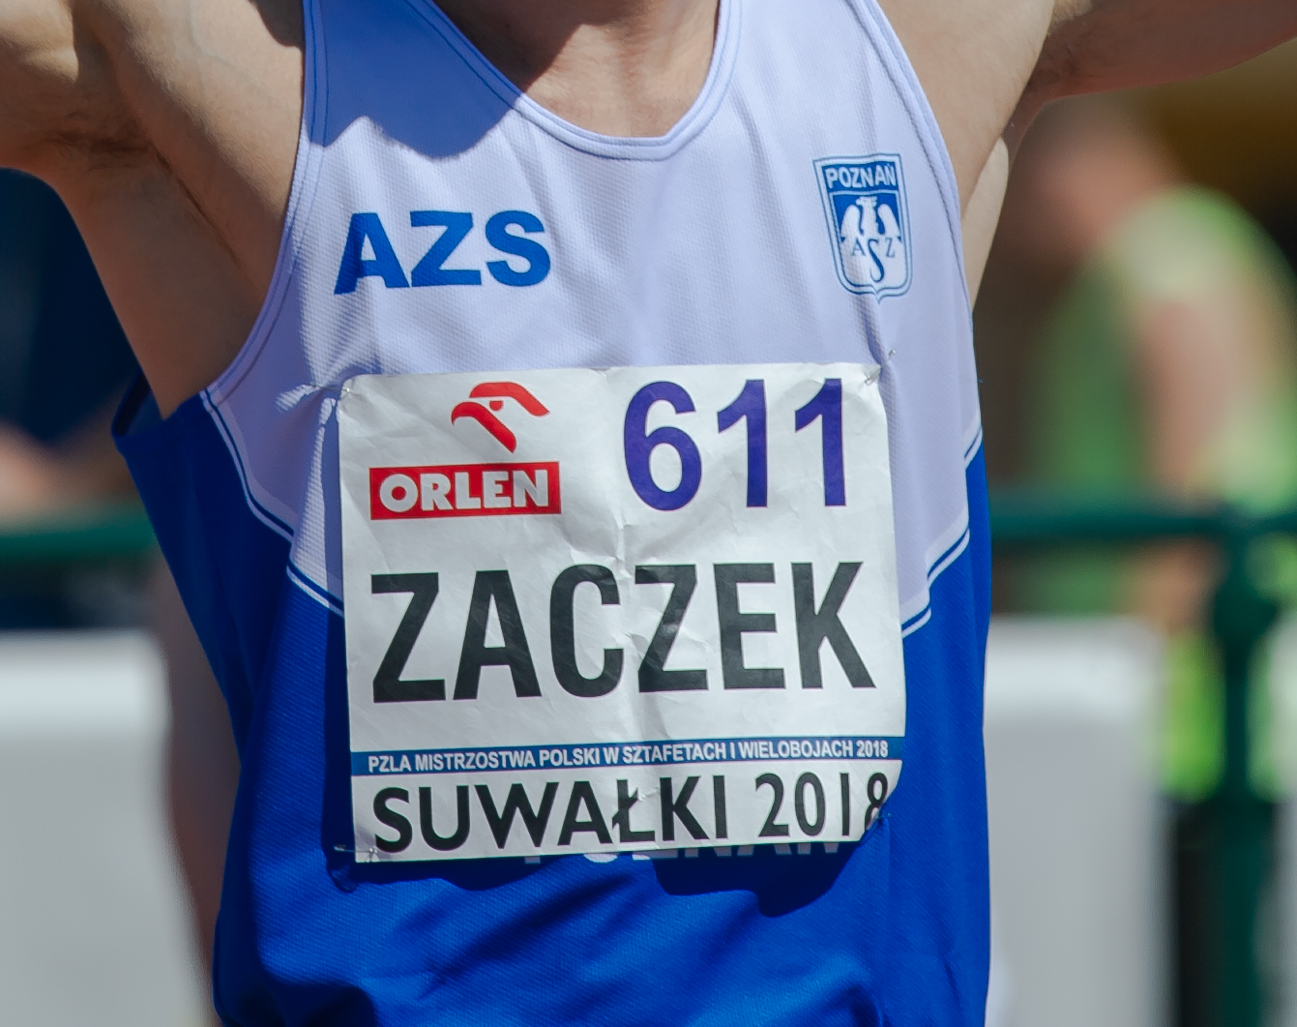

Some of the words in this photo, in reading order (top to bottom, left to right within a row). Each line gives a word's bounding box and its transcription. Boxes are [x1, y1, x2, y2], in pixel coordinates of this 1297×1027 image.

[824, 163, 897, 189] POZNAŃ
[334, 210, 551, 295] AZS
[623, 378, 847, 511] 611
[378, 469, 550, 514] ORLEN
[370, 561, 876, 704] ZACZEK
[368, 755, 412, 773] PZLA
[415, 750, 536, 771] MISTRZOSTWA
[539, 747, 600, 767] POLSKI
[603, 747, 620, 764] W
[622, 742, 727, 764] SZTAFETACH
[730, 742, 736, 759] I
[738, 739, 853, 759] WIELOBOJACH
[856, 739, 889, 758] 2018
[373, 774, 728, 853] SUWAŁKI
[755, 772, 889, 838] 2018
